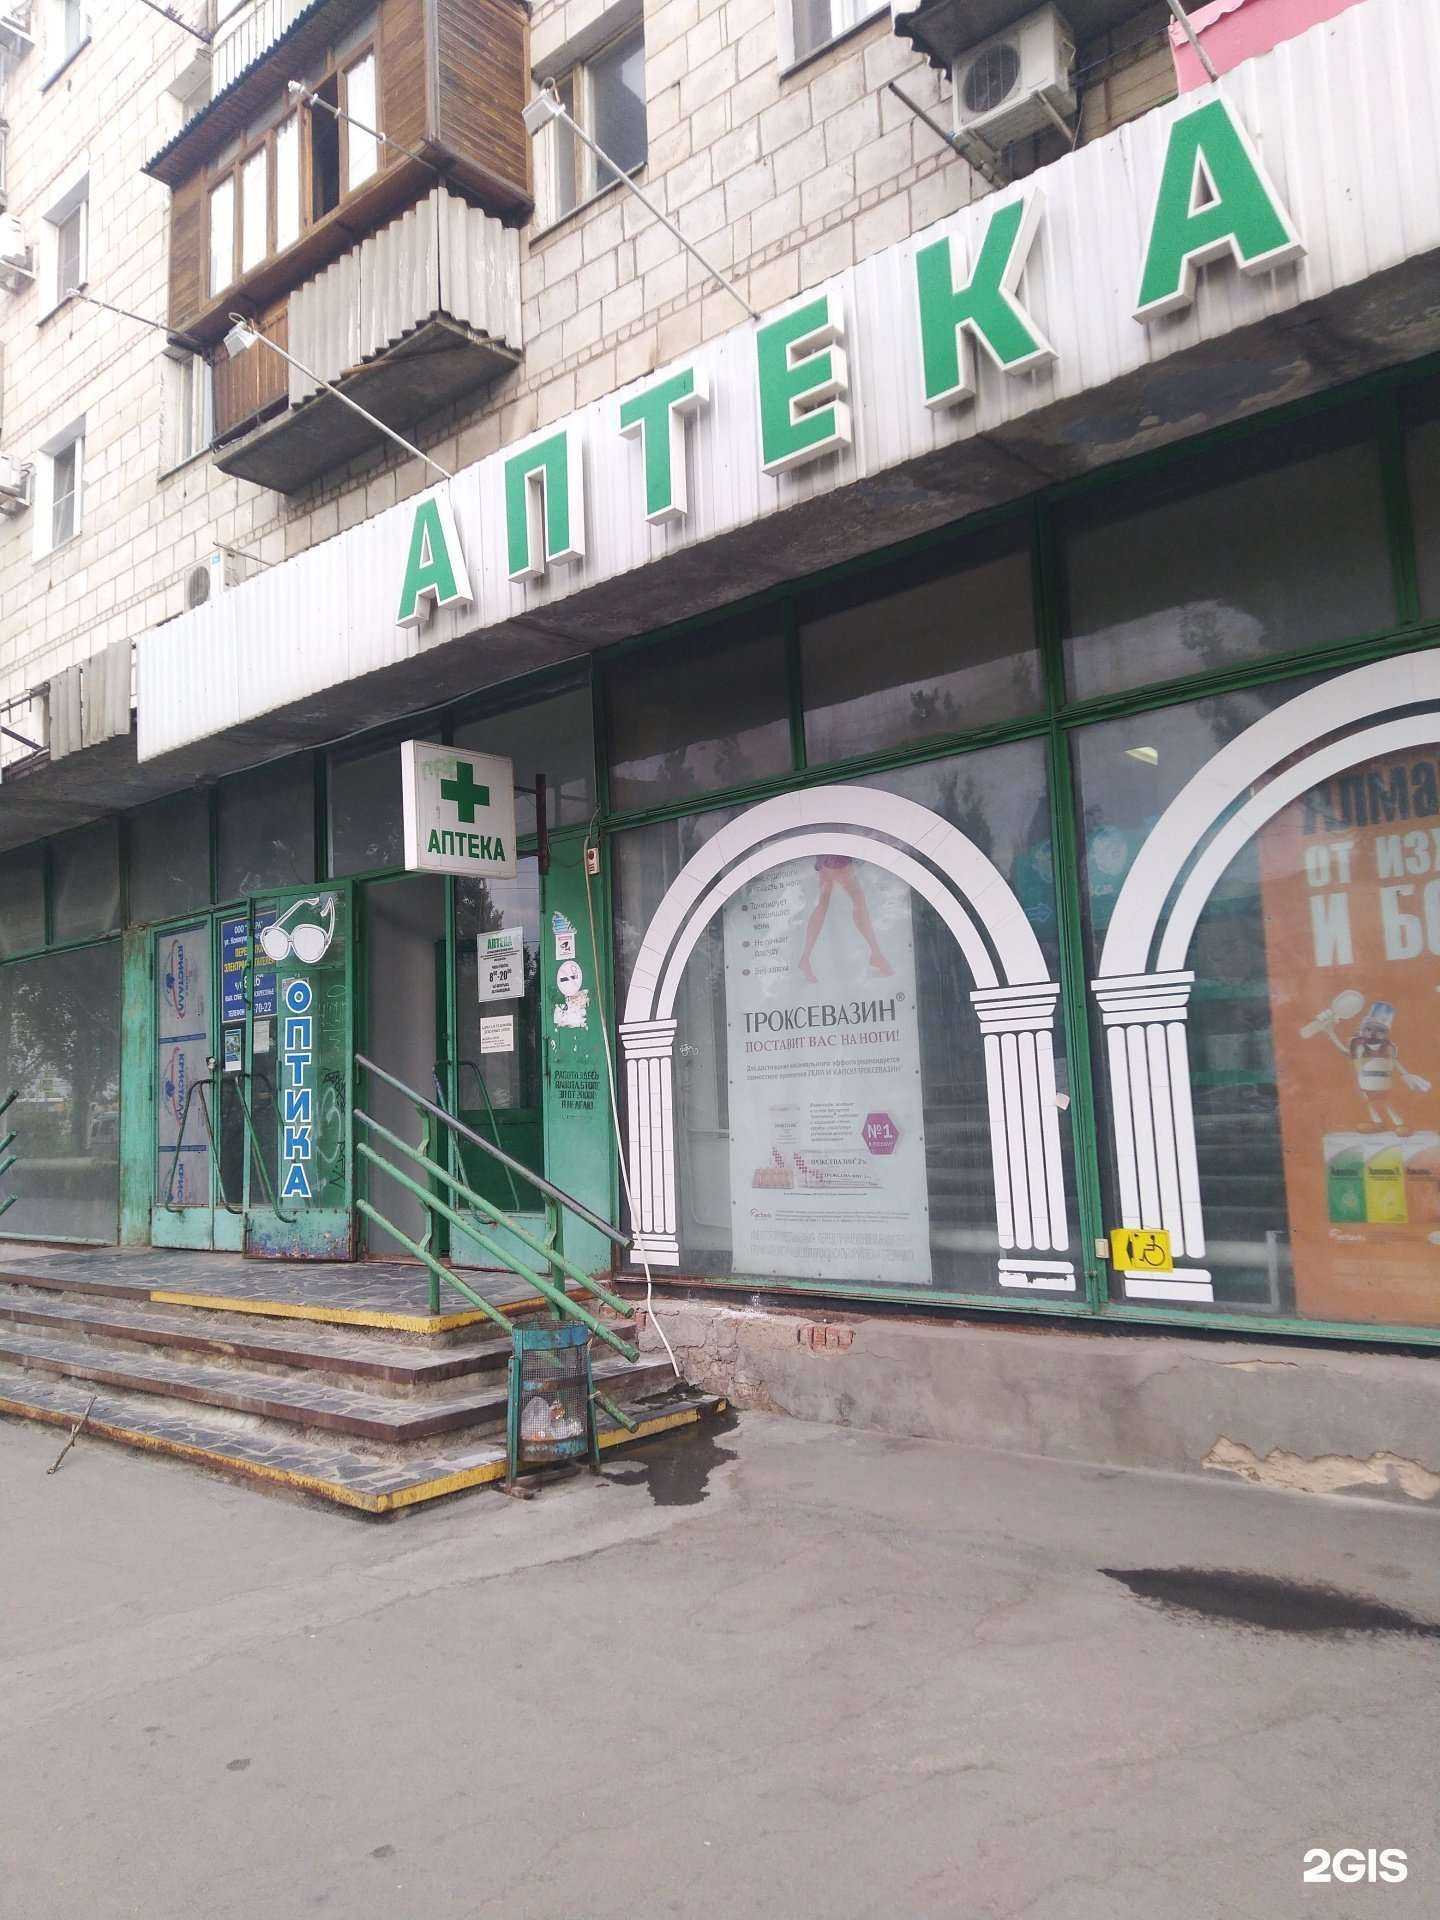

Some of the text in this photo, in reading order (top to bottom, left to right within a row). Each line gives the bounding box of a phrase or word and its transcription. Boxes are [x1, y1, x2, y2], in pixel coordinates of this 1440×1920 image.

[397, 95, 1306, 625] АПТЕКА
[427, 828, 506, 862] АПТЕКА
[1304, 827, 1440, 887] ОТ ИЗ
[1310, 892, 1354, 967] И
[745, 1029, 900, 1053] ПОСТАВИТ ВАС НА НОГИ!
[281, 980, 312, 1198] ОПТИКА
